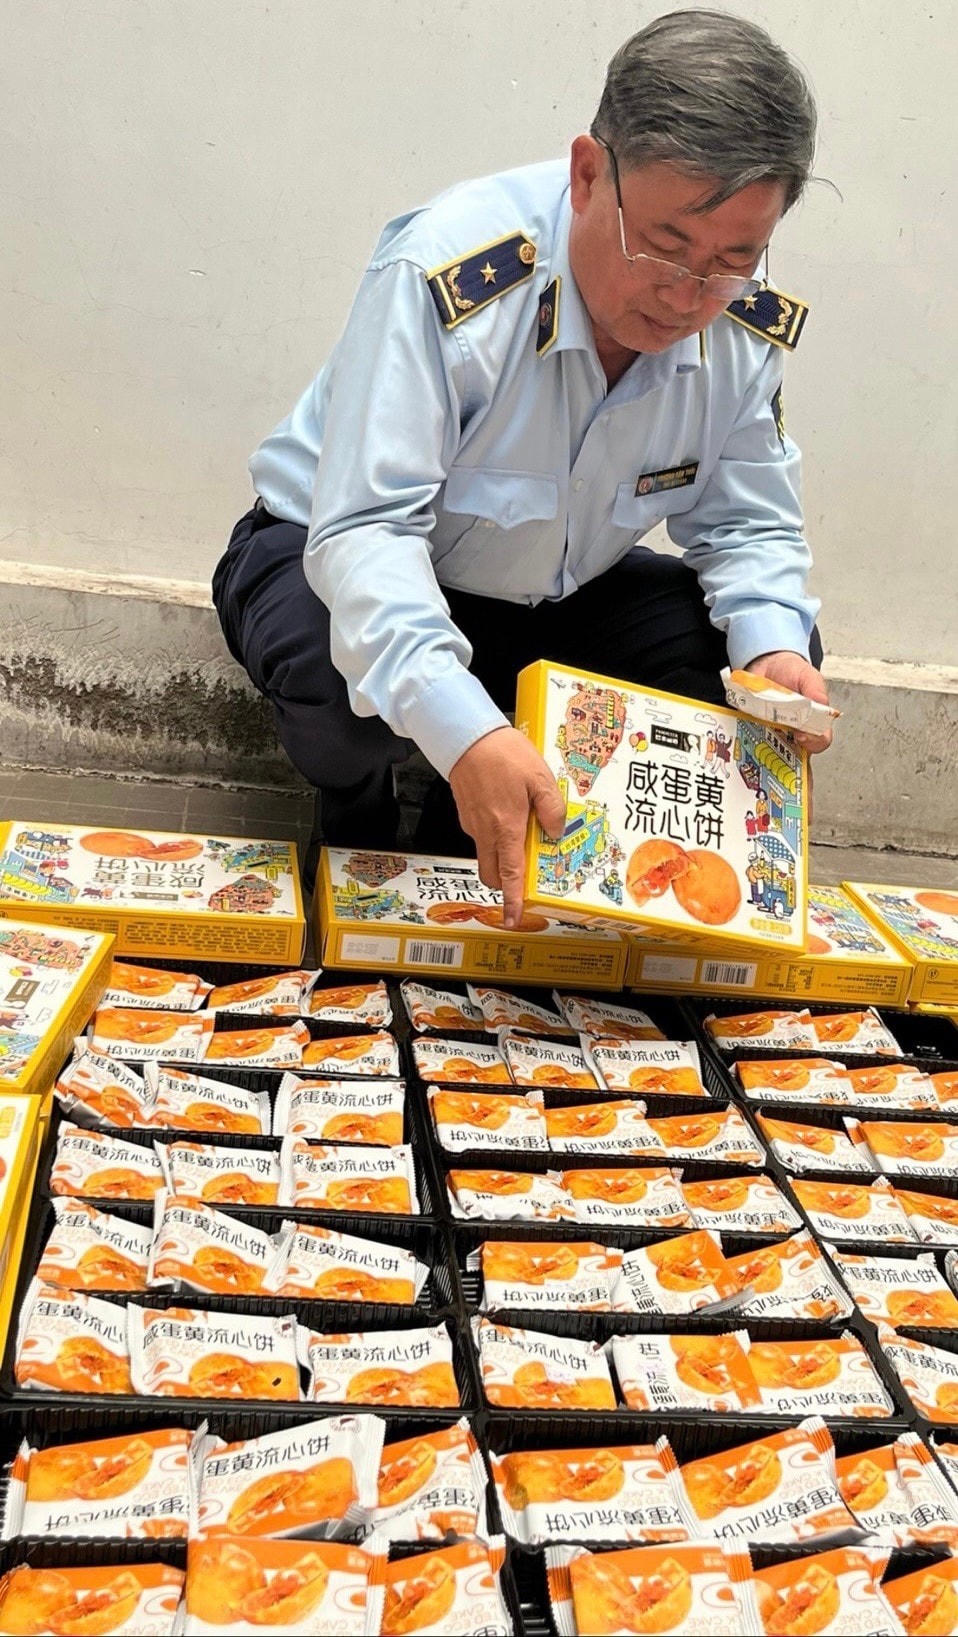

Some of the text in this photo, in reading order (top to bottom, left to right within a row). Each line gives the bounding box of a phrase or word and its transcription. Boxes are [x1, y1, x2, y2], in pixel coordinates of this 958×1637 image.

[626, 760, 725, 813] 咸蛋黄
[624, 794, 725, 850] 流心饼
[95, 856, 206, 872] 流心饼
[92, 871, 206, 888] 咸蛋黄
[416, 876, 483, 892] 咸蛋
[158, 1074, 249, 1110] 蛋黄流心饼
[450, 1130, 546, 1149] 蛋黄流心饼
[170, 1150, 272, 1176] 蛋黄流心饼
[586, 1203, 686, 1217] 蛋黄流心饼
[162, 1210, 266, 1259] 蛋黄流心饼
[310, 1341, 432, 1363] 蛋黄流心饼
[205, 1435, 330, 1478] 蛋黄流心饼
[45, 1494, 190, 1532] 蛋黄流心饼
